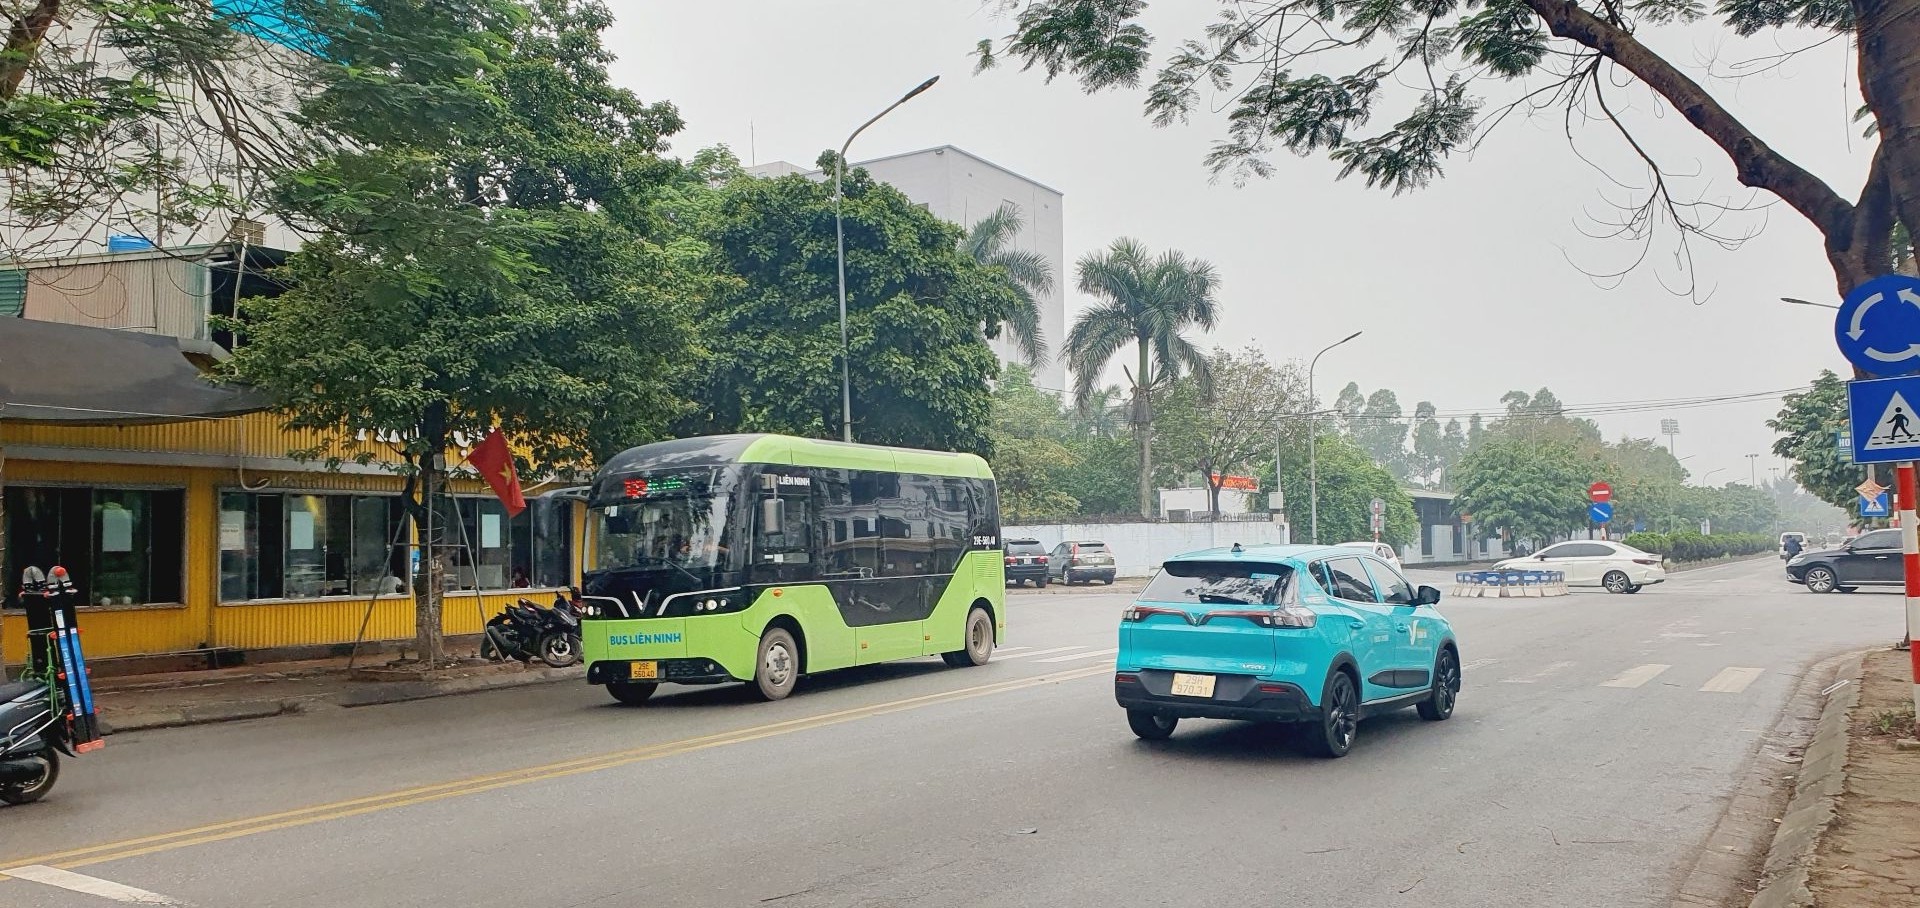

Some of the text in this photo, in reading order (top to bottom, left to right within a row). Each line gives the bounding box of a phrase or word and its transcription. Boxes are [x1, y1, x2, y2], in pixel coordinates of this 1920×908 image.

[778, 474, 810, 487] LIÊN NINH
[610, 632, 682, 646] BUS LIÊN NINH
[638, 662, 650, 670] 29E
[633, 670, 655, 678] 560.40
[1184, 675, 1203, 685] 29H
[1176, 684, 1208, 696] 970.31
